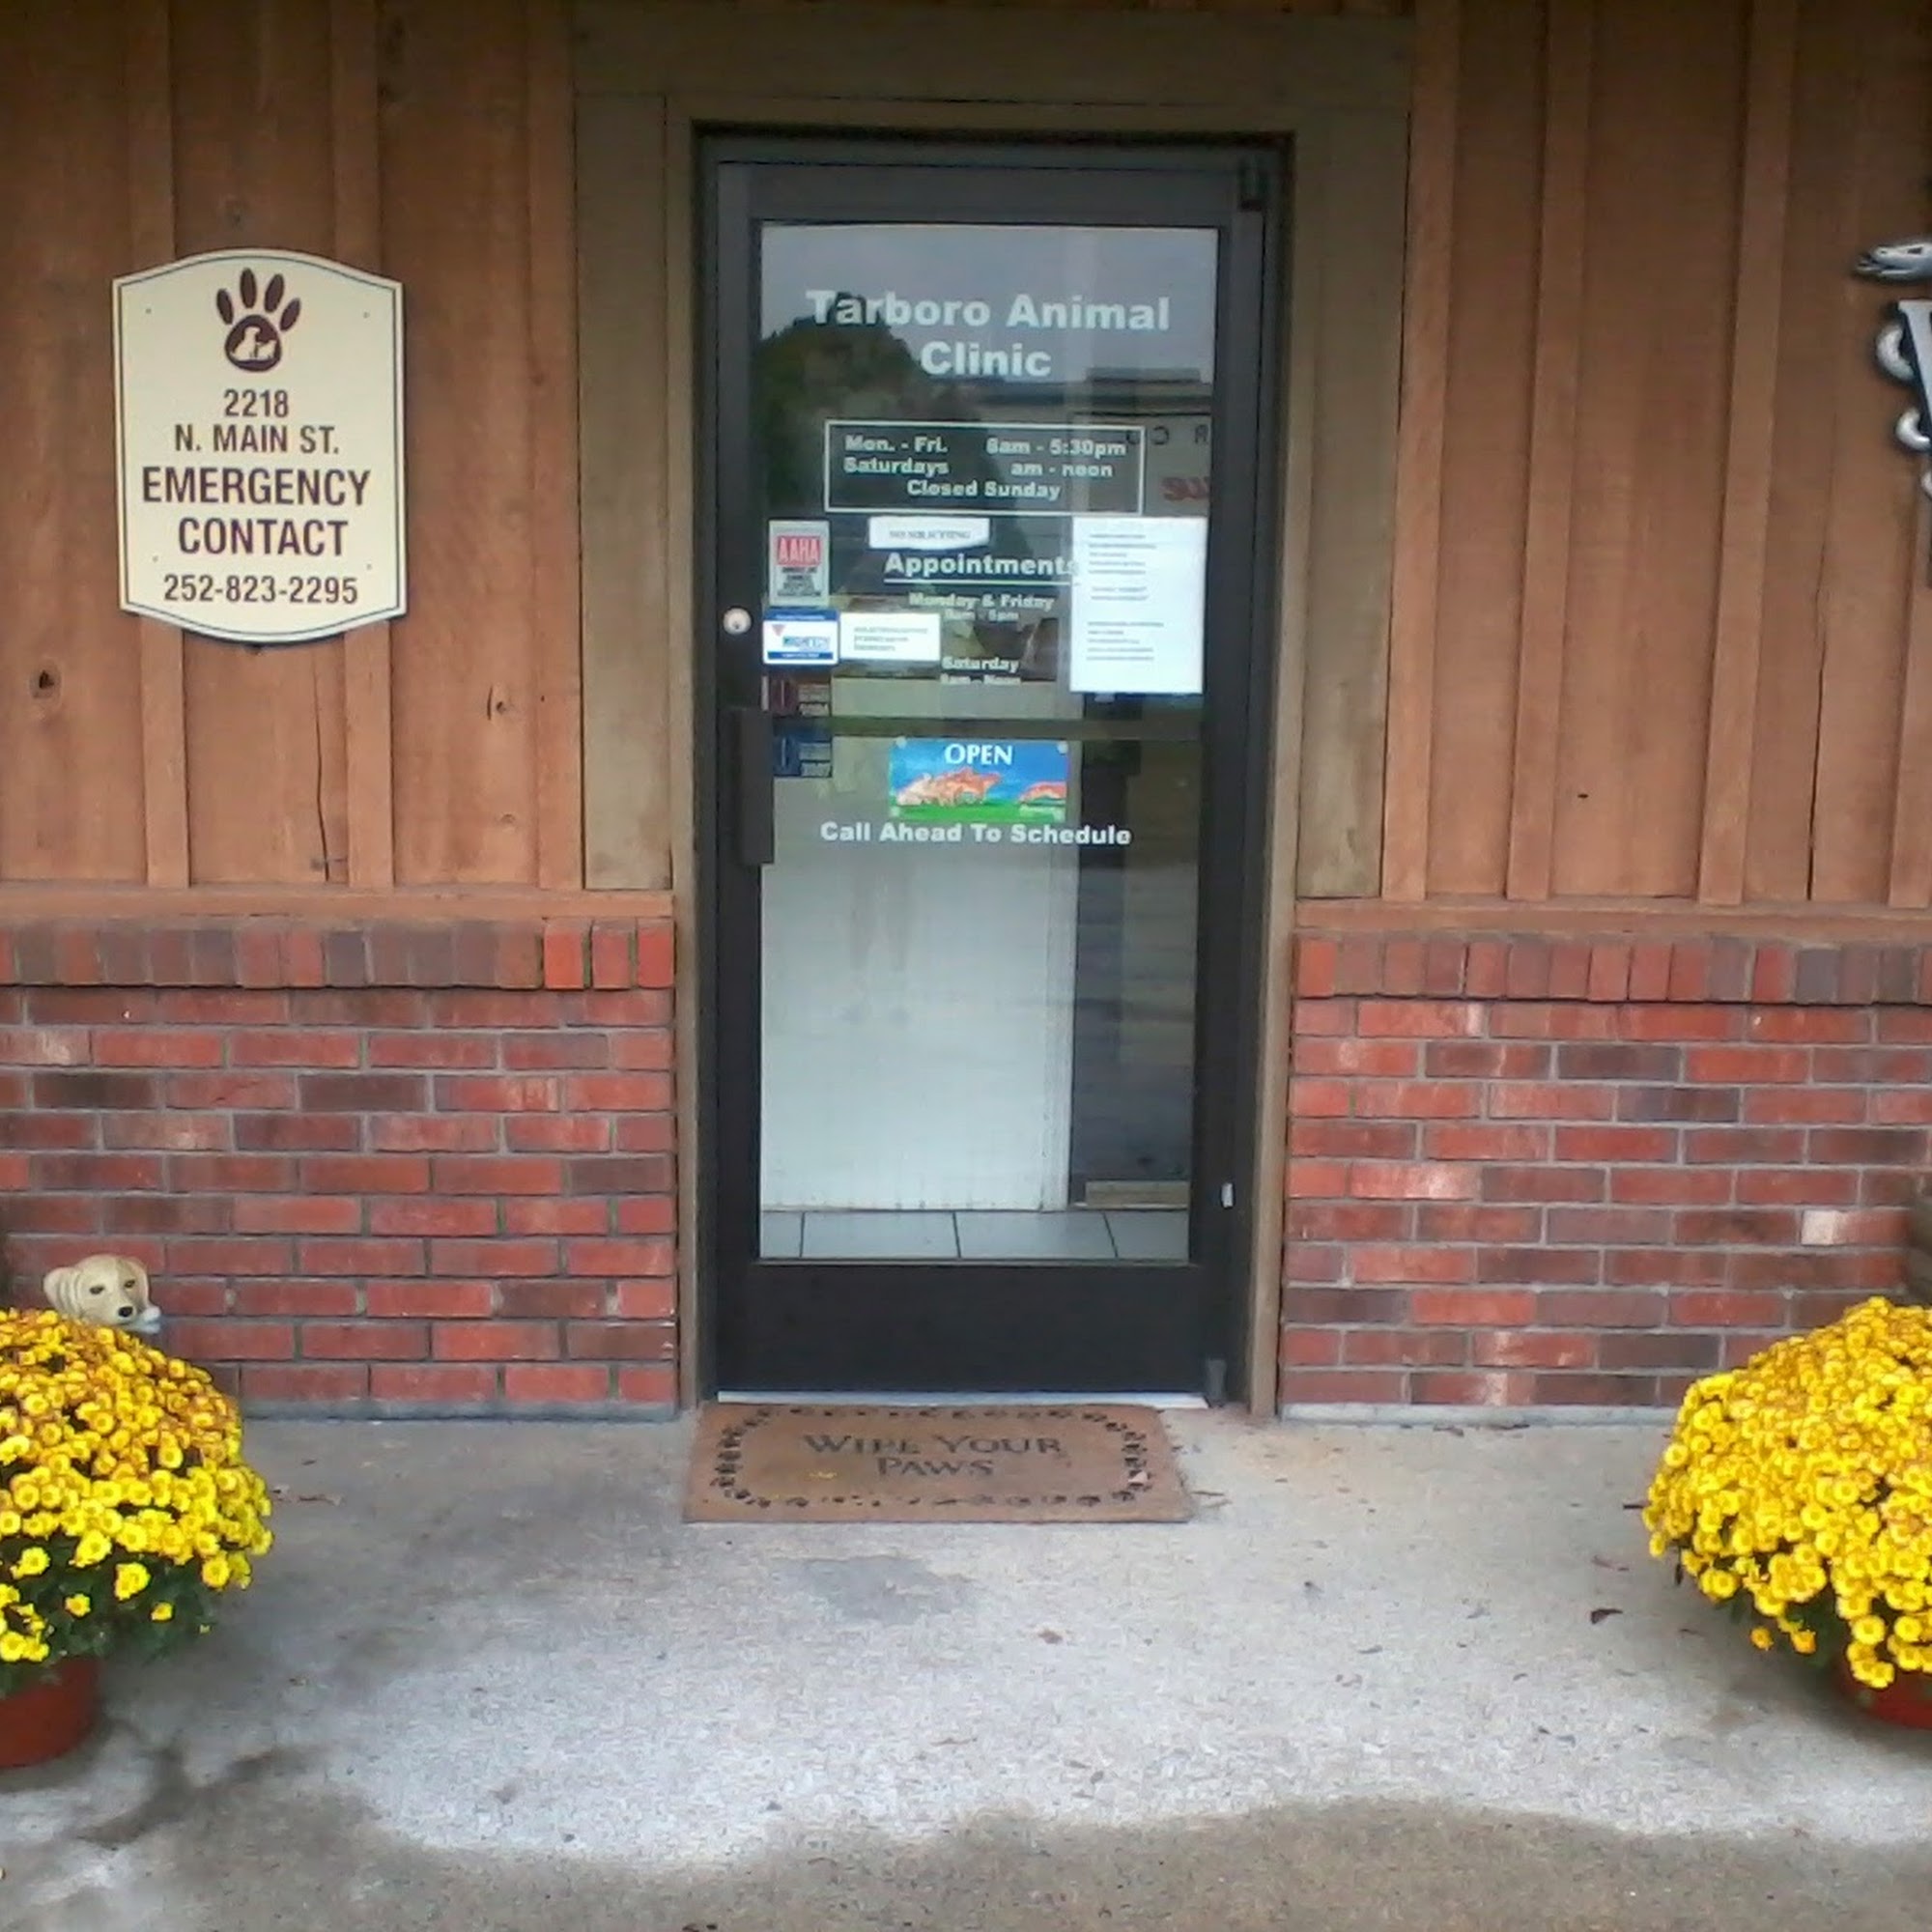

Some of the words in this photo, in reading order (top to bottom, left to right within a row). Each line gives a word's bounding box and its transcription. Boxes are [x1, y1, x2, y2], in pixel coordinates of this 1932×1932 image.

[806, 291, 989, 327] Tarboro
[1006, 295, 1170, 331] Animal
[920, 341, 1051, 377] Clinic
[224, 389, 289, 417] 2218
[175, 424, 201, 451] N.
[213, 425, 288, 452] MAIN
[299, 426, 339, 454] ST.
[844, 435, 895, 452] Mon.
[914, 435, 949, 452] Fri.
[843, 457, 949, 477] Saturdays
[1063, 464, 1113, 477] noon
[142, 466, 371, 506] EMERGENCY
[907, 479, 978, 497] Closed
[984, 481, 1060, 500] Sunday
[179, 518, 348, 555] CONTACT
[779, 537, 820, 564] AAHA
[163, 575, 358, 604] 252-823-2295
[909, 592, 980, 610] Monday
[982, 593, 994, 607] &
[1001, 594, 1054, 612] Friday
[942, 657, 1019, 672] Saturday
[945, 743, 1012, 765] OPEN
[821, 822, 869, 841] Call
[879, 823, 961, 842] Ahead
[970, 823, 1002, 843] To
[1010, 824, 1131, 845] Schedule
[803, 1435, 921, 1454] WIPE
[932, 1435, 1062, 1454] YOUR
[877, 1457, 993, 1475] PAWS
